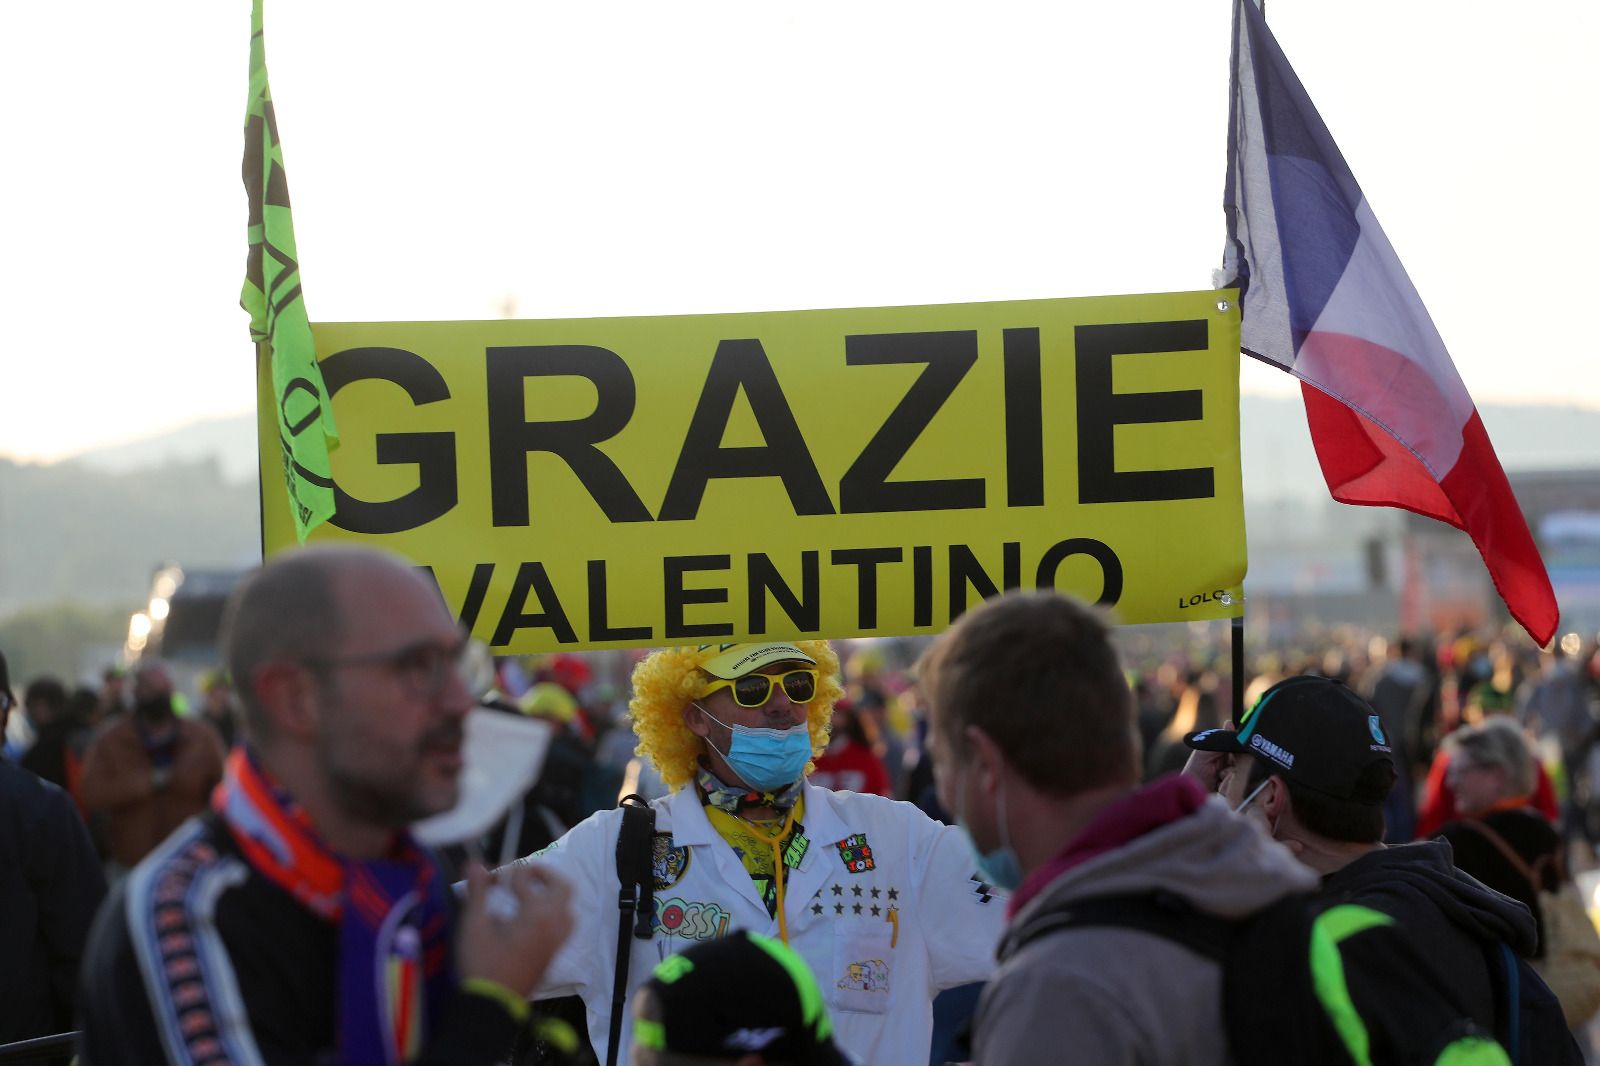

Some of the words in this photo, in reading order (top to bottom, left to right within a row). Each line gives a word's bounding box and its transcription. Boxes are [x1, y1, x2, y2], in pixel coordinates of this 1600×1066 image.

[317, 318, 1215, 535] GRAZIE
[1261, 738, 1295, 767] YAMAHA
[839, 835, 866, 849] THE
